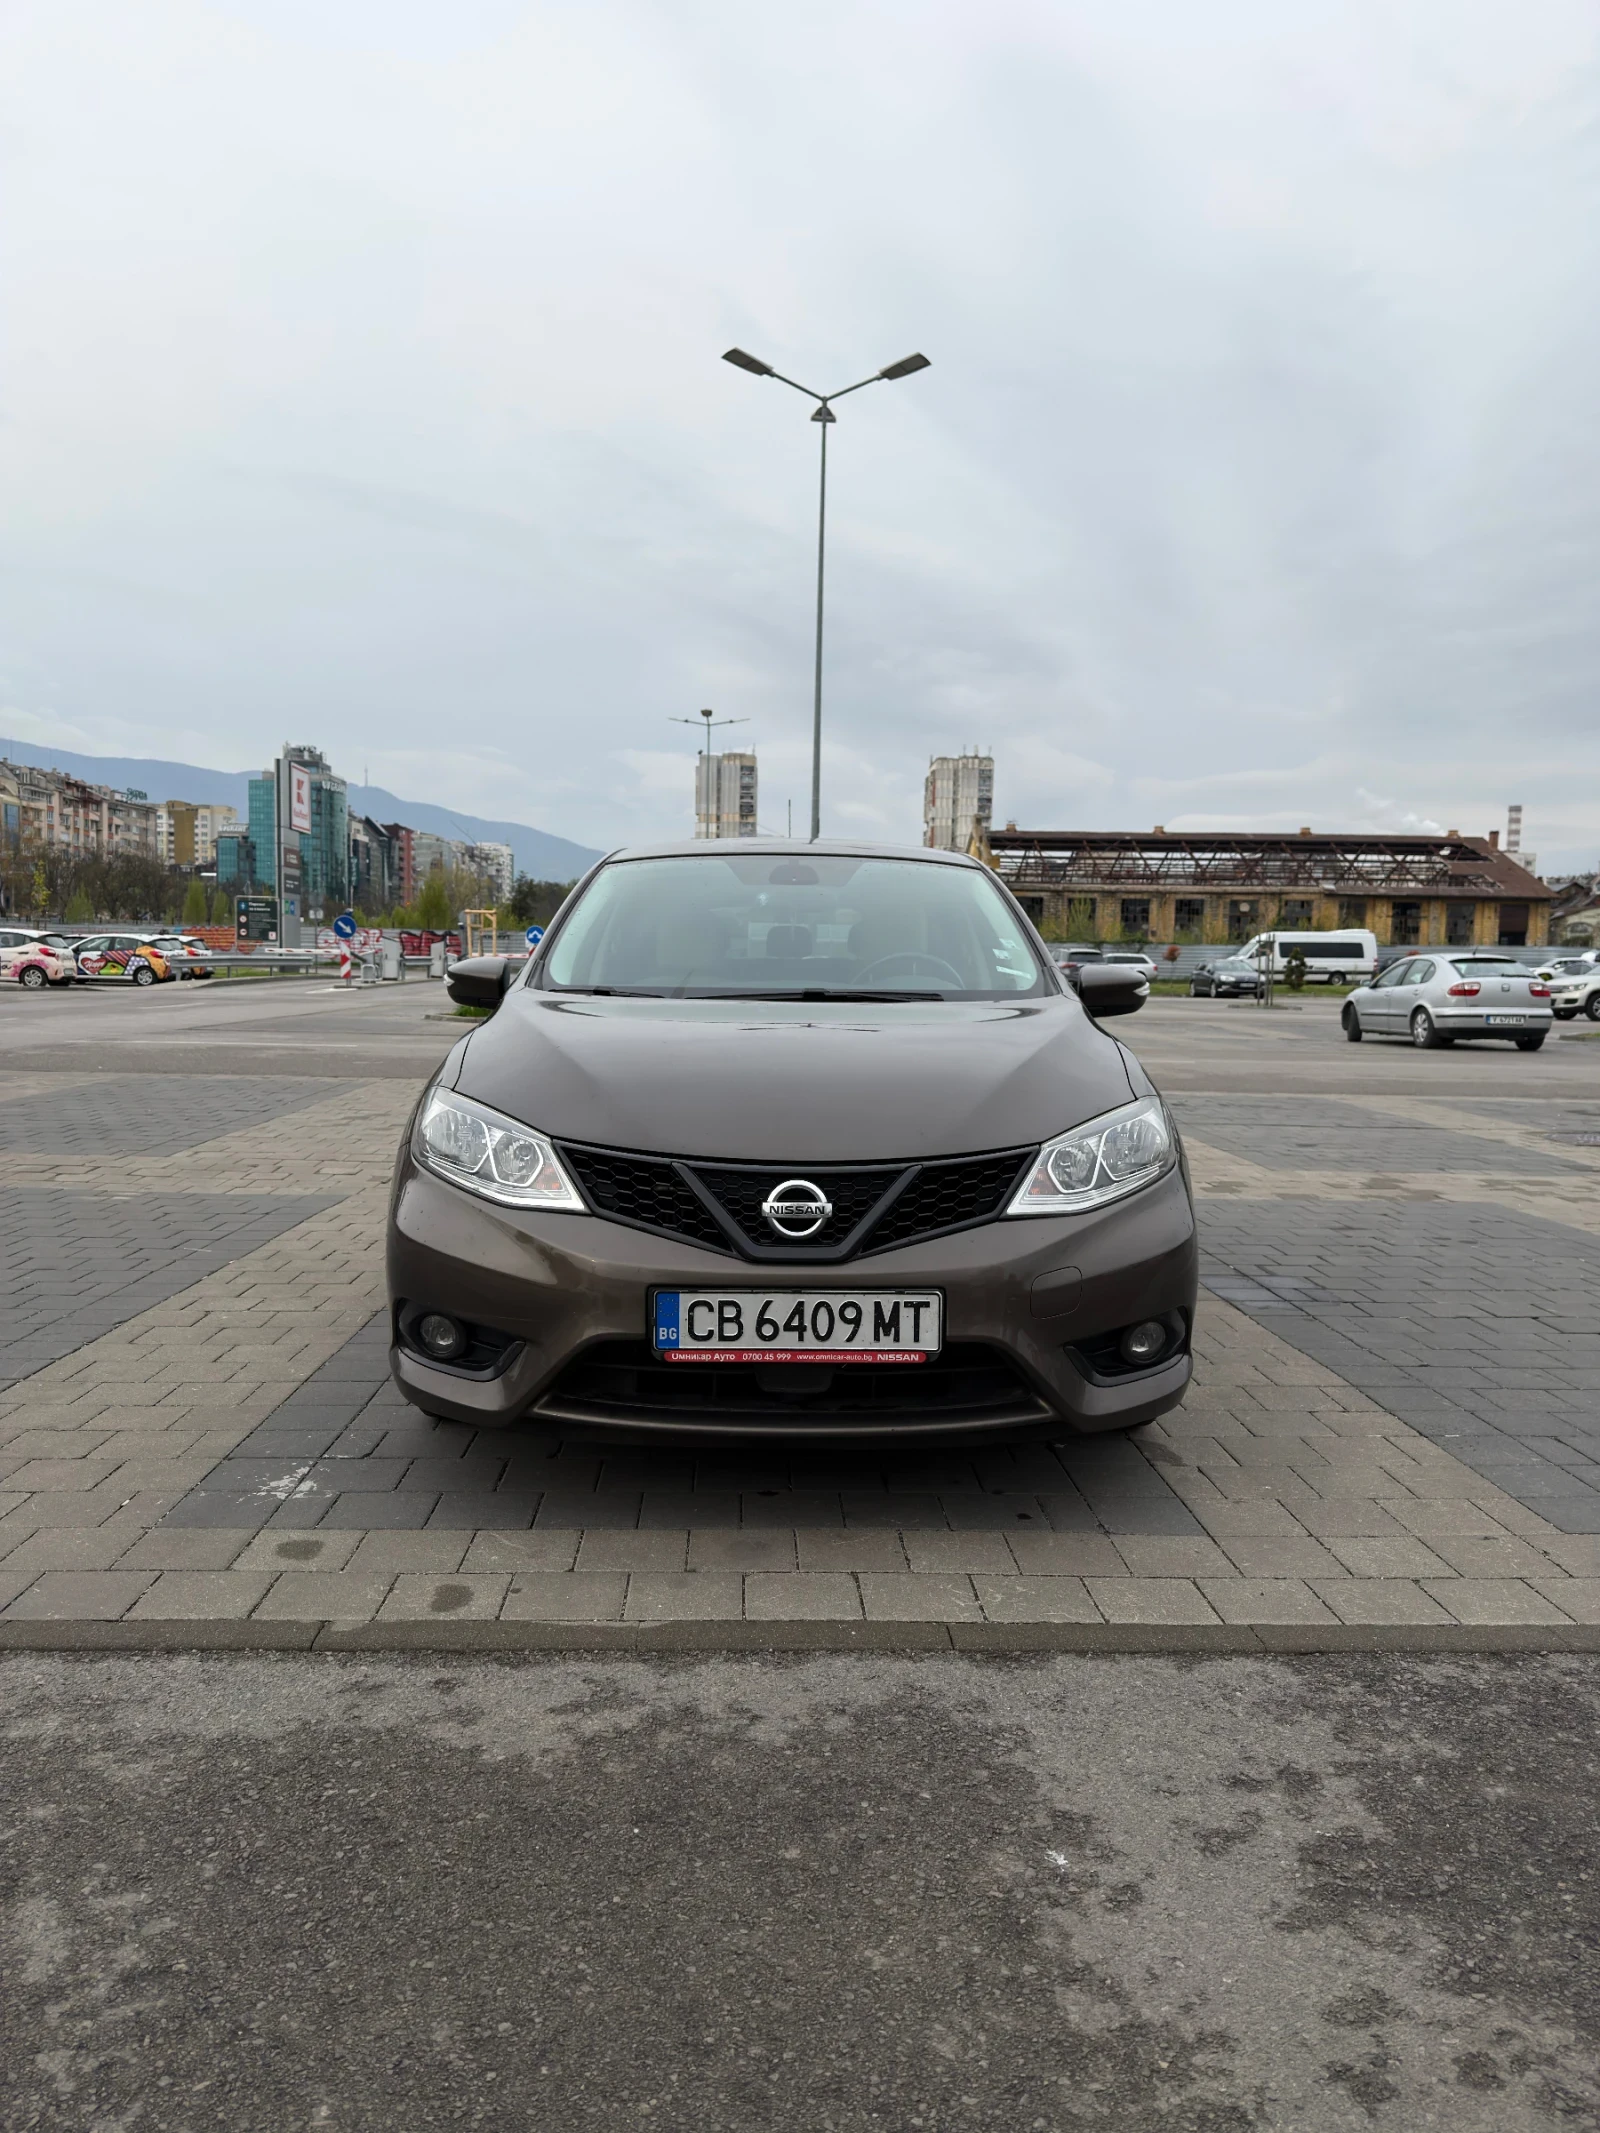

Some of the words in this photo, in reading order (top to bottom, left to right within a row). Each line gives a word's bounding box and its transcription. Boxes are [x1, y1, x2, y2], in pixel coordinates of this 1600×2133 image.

[769, 1205, 825, 1215] NISSAN
[687, 1300, 744, 1343] CB
[755, 1300, 863, 1343] 6409
[873, 1300, 931, 1343] MT
[659, 1327, 677, 1340] BG
[713, 1352, 736, 1362] Ауто
[742, 1353, 763, 1361] 0700
[765, 1353, 775, 1361] 45
[776, 1353, 791, 1361] 999
[796, 1353, 873, 1362] www.omnicar-auto.bg
[877, 1353, 919, 1361] NISSAN
